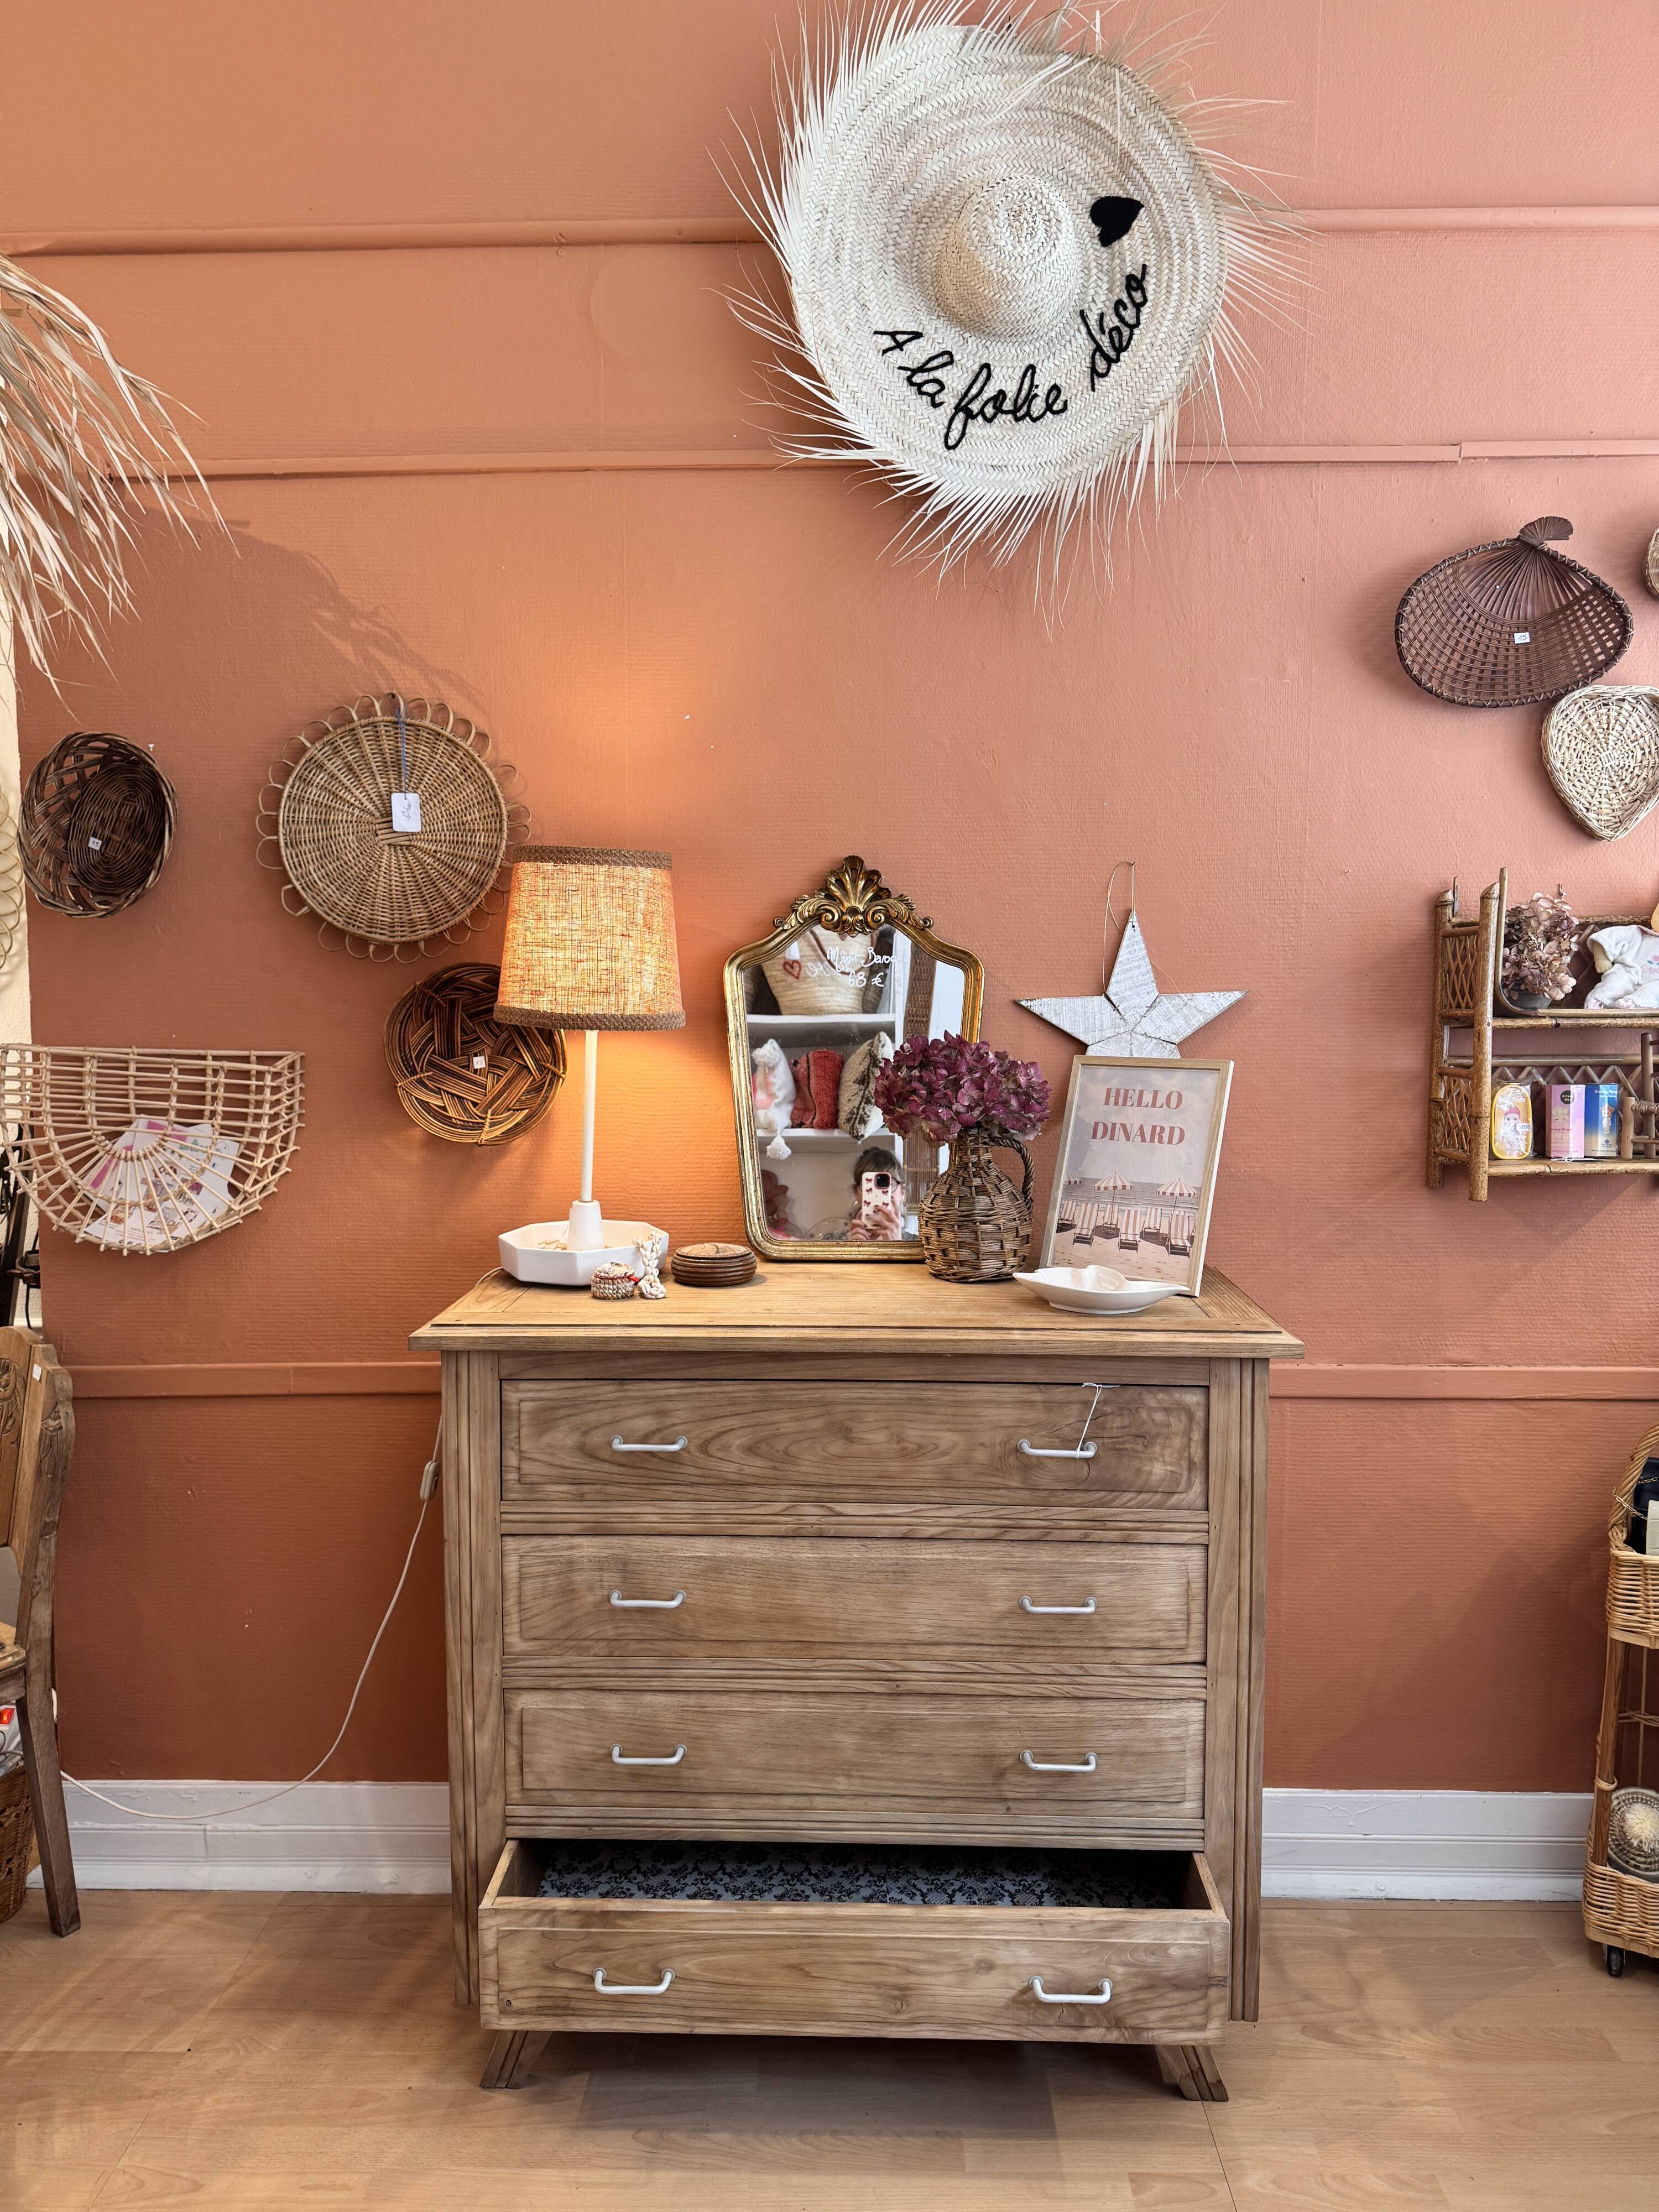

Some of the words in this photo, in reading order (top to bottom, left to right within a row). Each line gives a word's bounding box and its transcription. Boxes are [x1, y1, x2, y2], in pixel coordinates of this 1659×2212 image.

[873, 330, 923, 356] A
[898, 349, 954, 408] la
[944, 362, 1068, 451] folie
[1079, 263, 1147, 392] déco
[848, 971, 867, 988] 68
[871, 972, 885, 987] €
[1103, 1087, 1183, 1110] HELLO
[1091, 1121, 1186, 1145] DINARD
